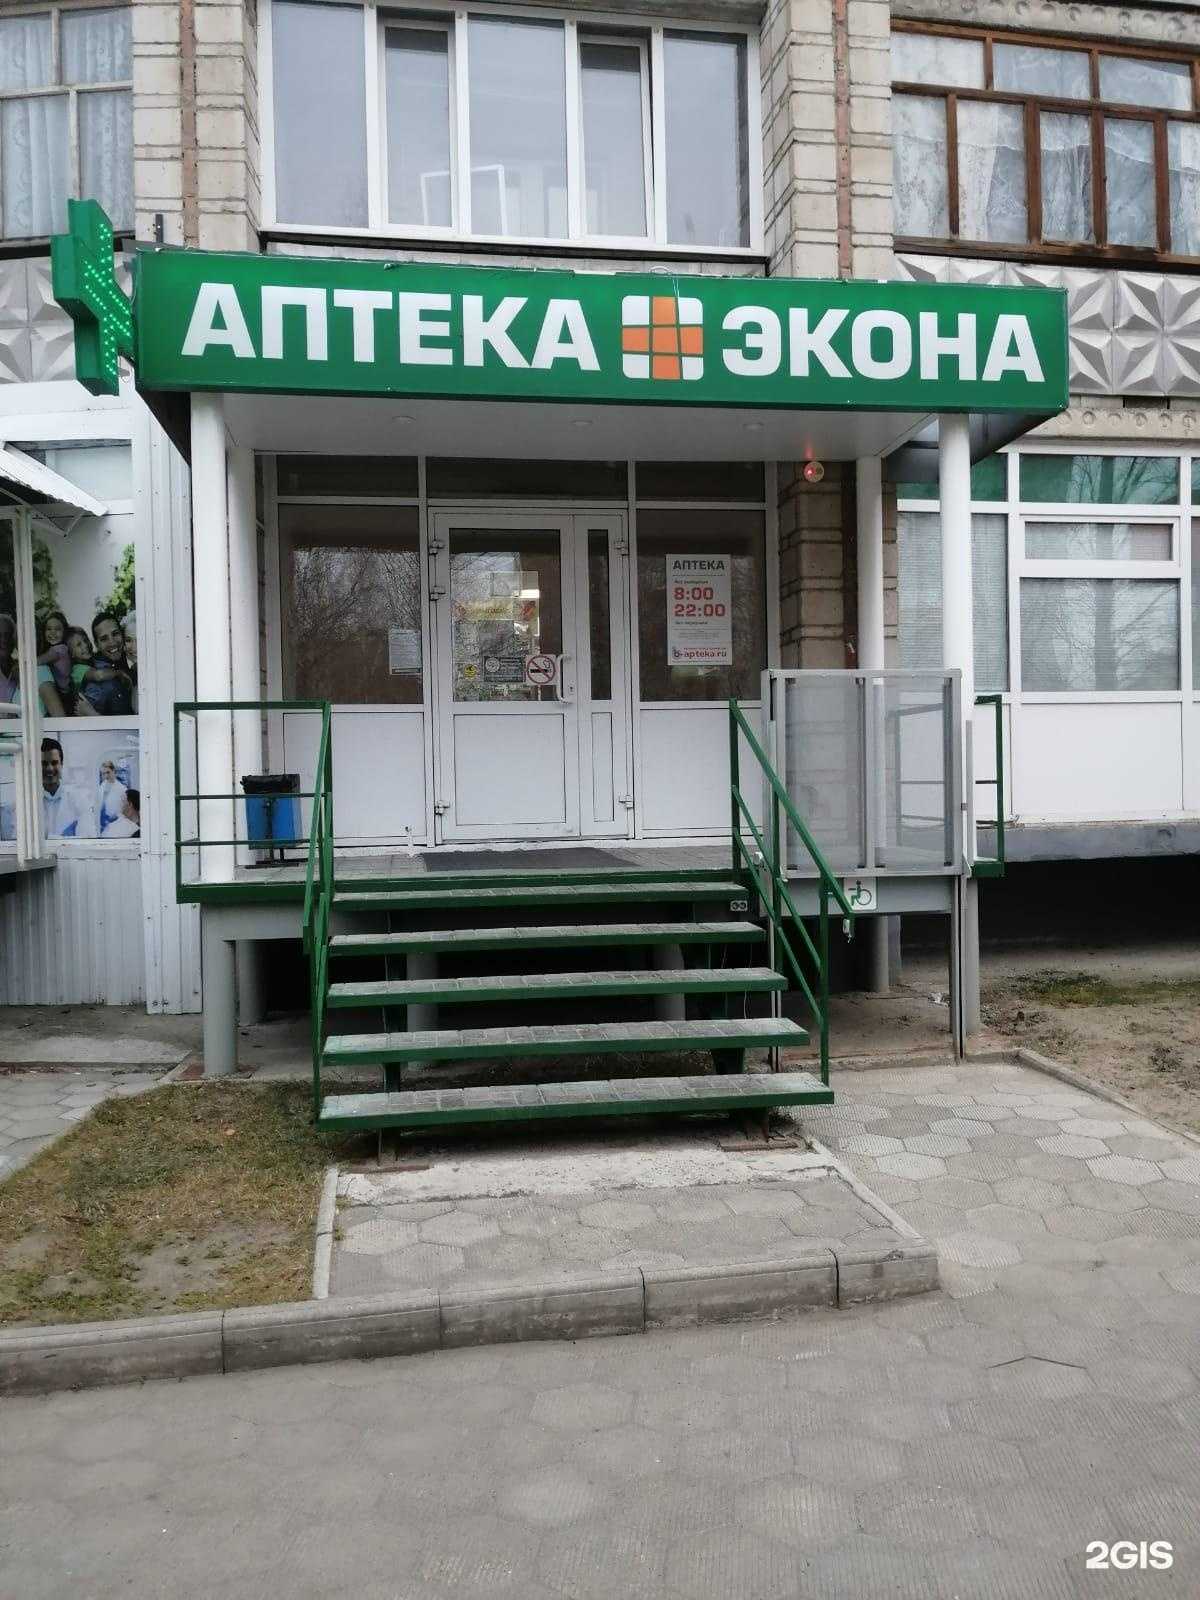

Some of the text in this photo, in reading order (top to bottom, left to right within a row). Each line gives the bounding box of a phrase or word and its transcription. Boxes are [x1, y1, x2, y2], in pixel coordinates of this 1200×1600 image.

[181, 282, 1046, 382] АПТЕКА ЭКОНА
[673, 560, 725, 570] АПТЕКА
[674, 587, 714, 600] 8:00
[674, 604, 726, 616] 22:00
